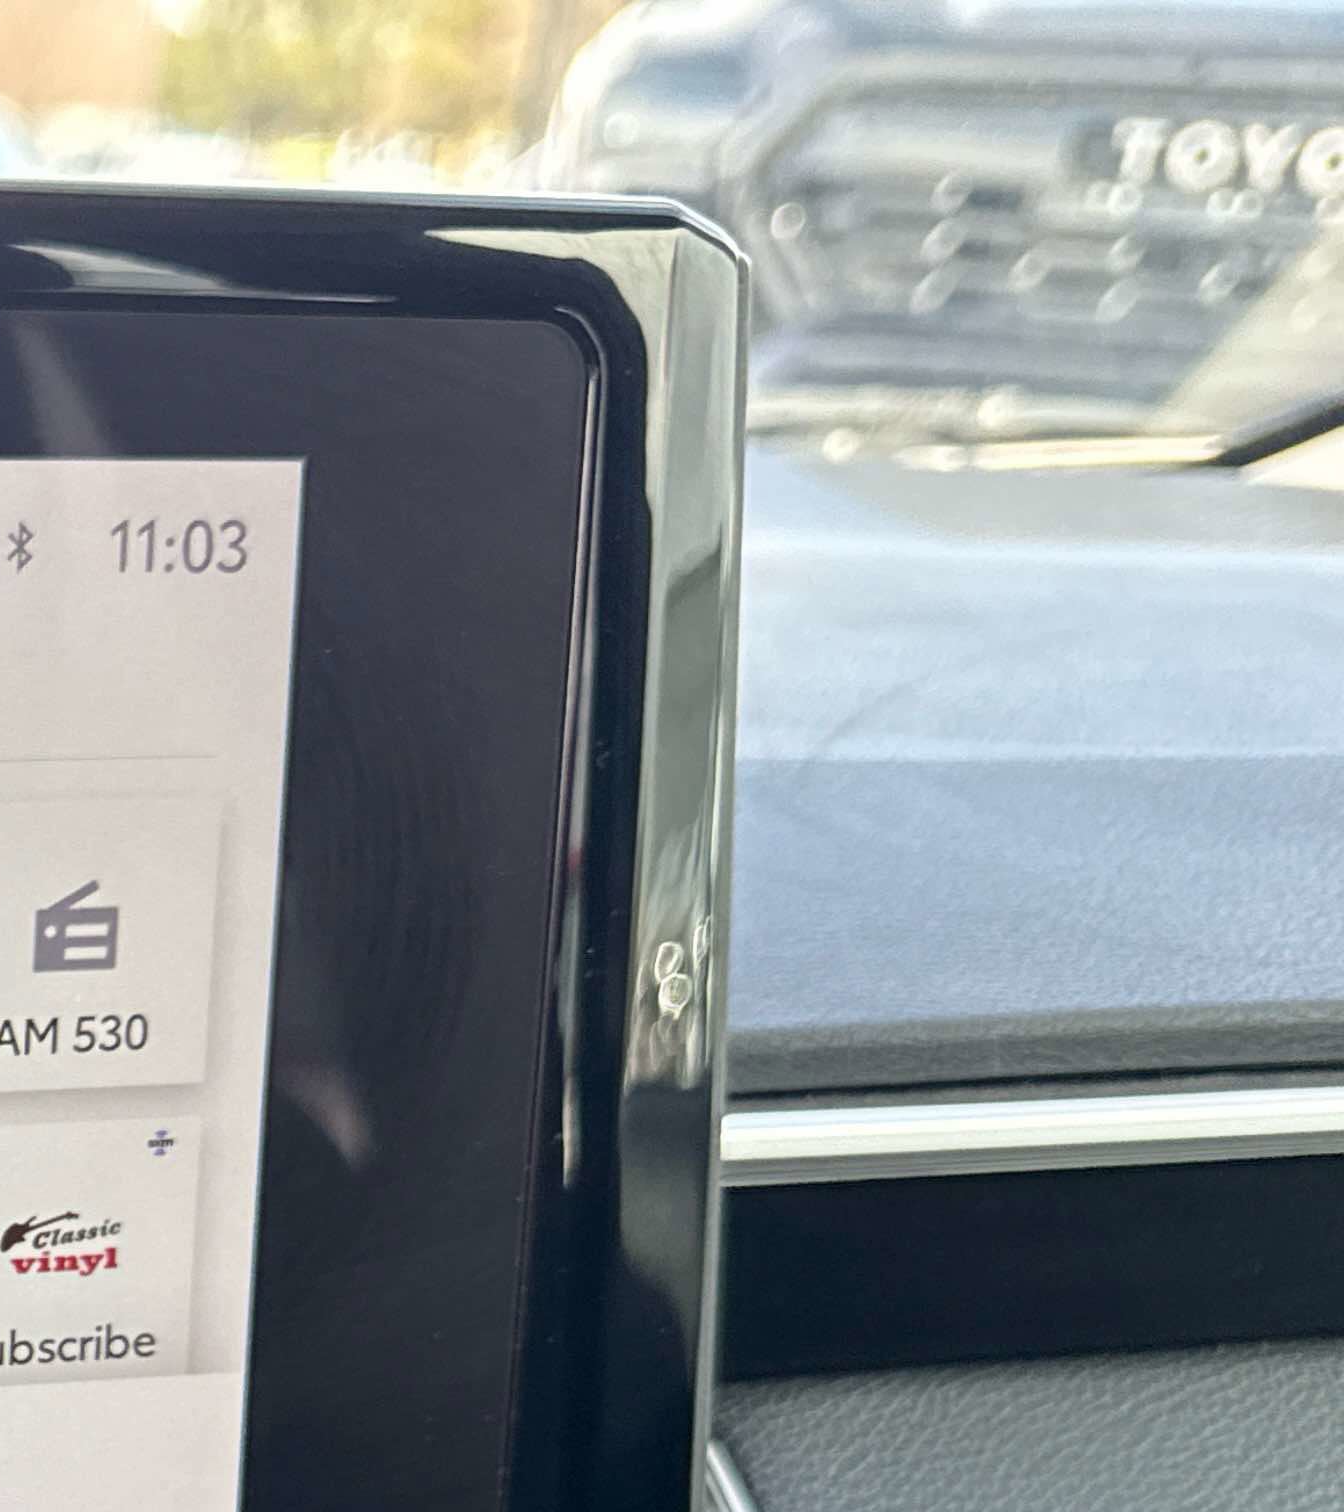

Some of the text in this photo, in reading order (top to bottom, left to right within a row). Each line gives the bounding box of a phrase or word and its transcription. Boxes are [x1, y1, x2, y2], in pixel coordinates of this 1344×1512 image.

[111, 519, 248, 574] 11:03
[73, 1013, 149, 1053] 530
[31, 1219, 122, 1249] Classic
[10, 1247, 118, 1276] vinyl
